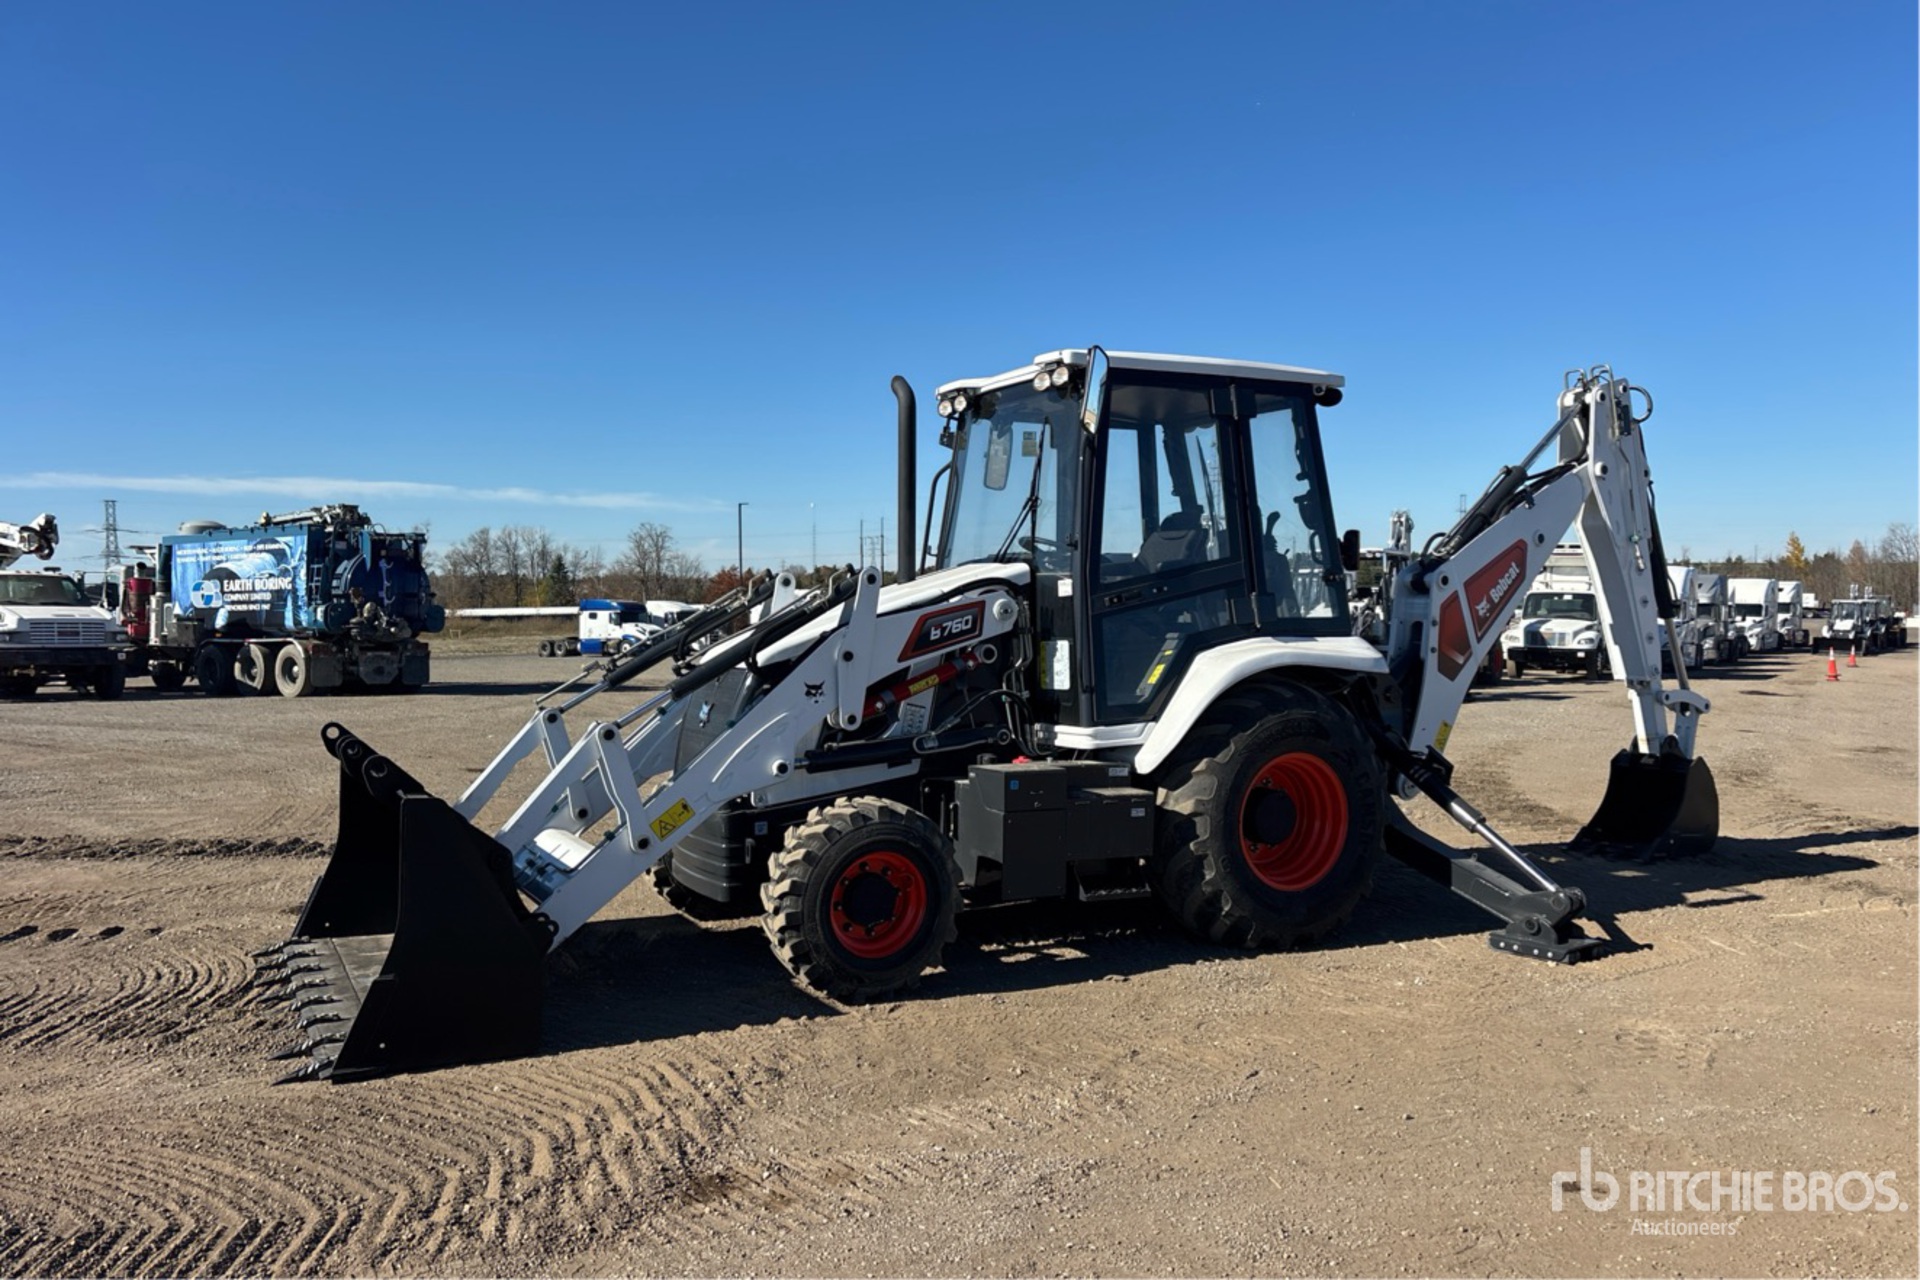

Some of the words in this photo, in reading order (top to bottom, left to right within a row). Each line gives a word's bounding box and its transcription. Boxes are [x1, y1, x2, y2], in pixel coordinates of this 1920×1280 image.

[223, 580, 252, 591] EARTH
[254, 577, 292, 590] BORING
[1490, 562, 1519, 603] Bobcat
[930, 615, 972, 641] B760
